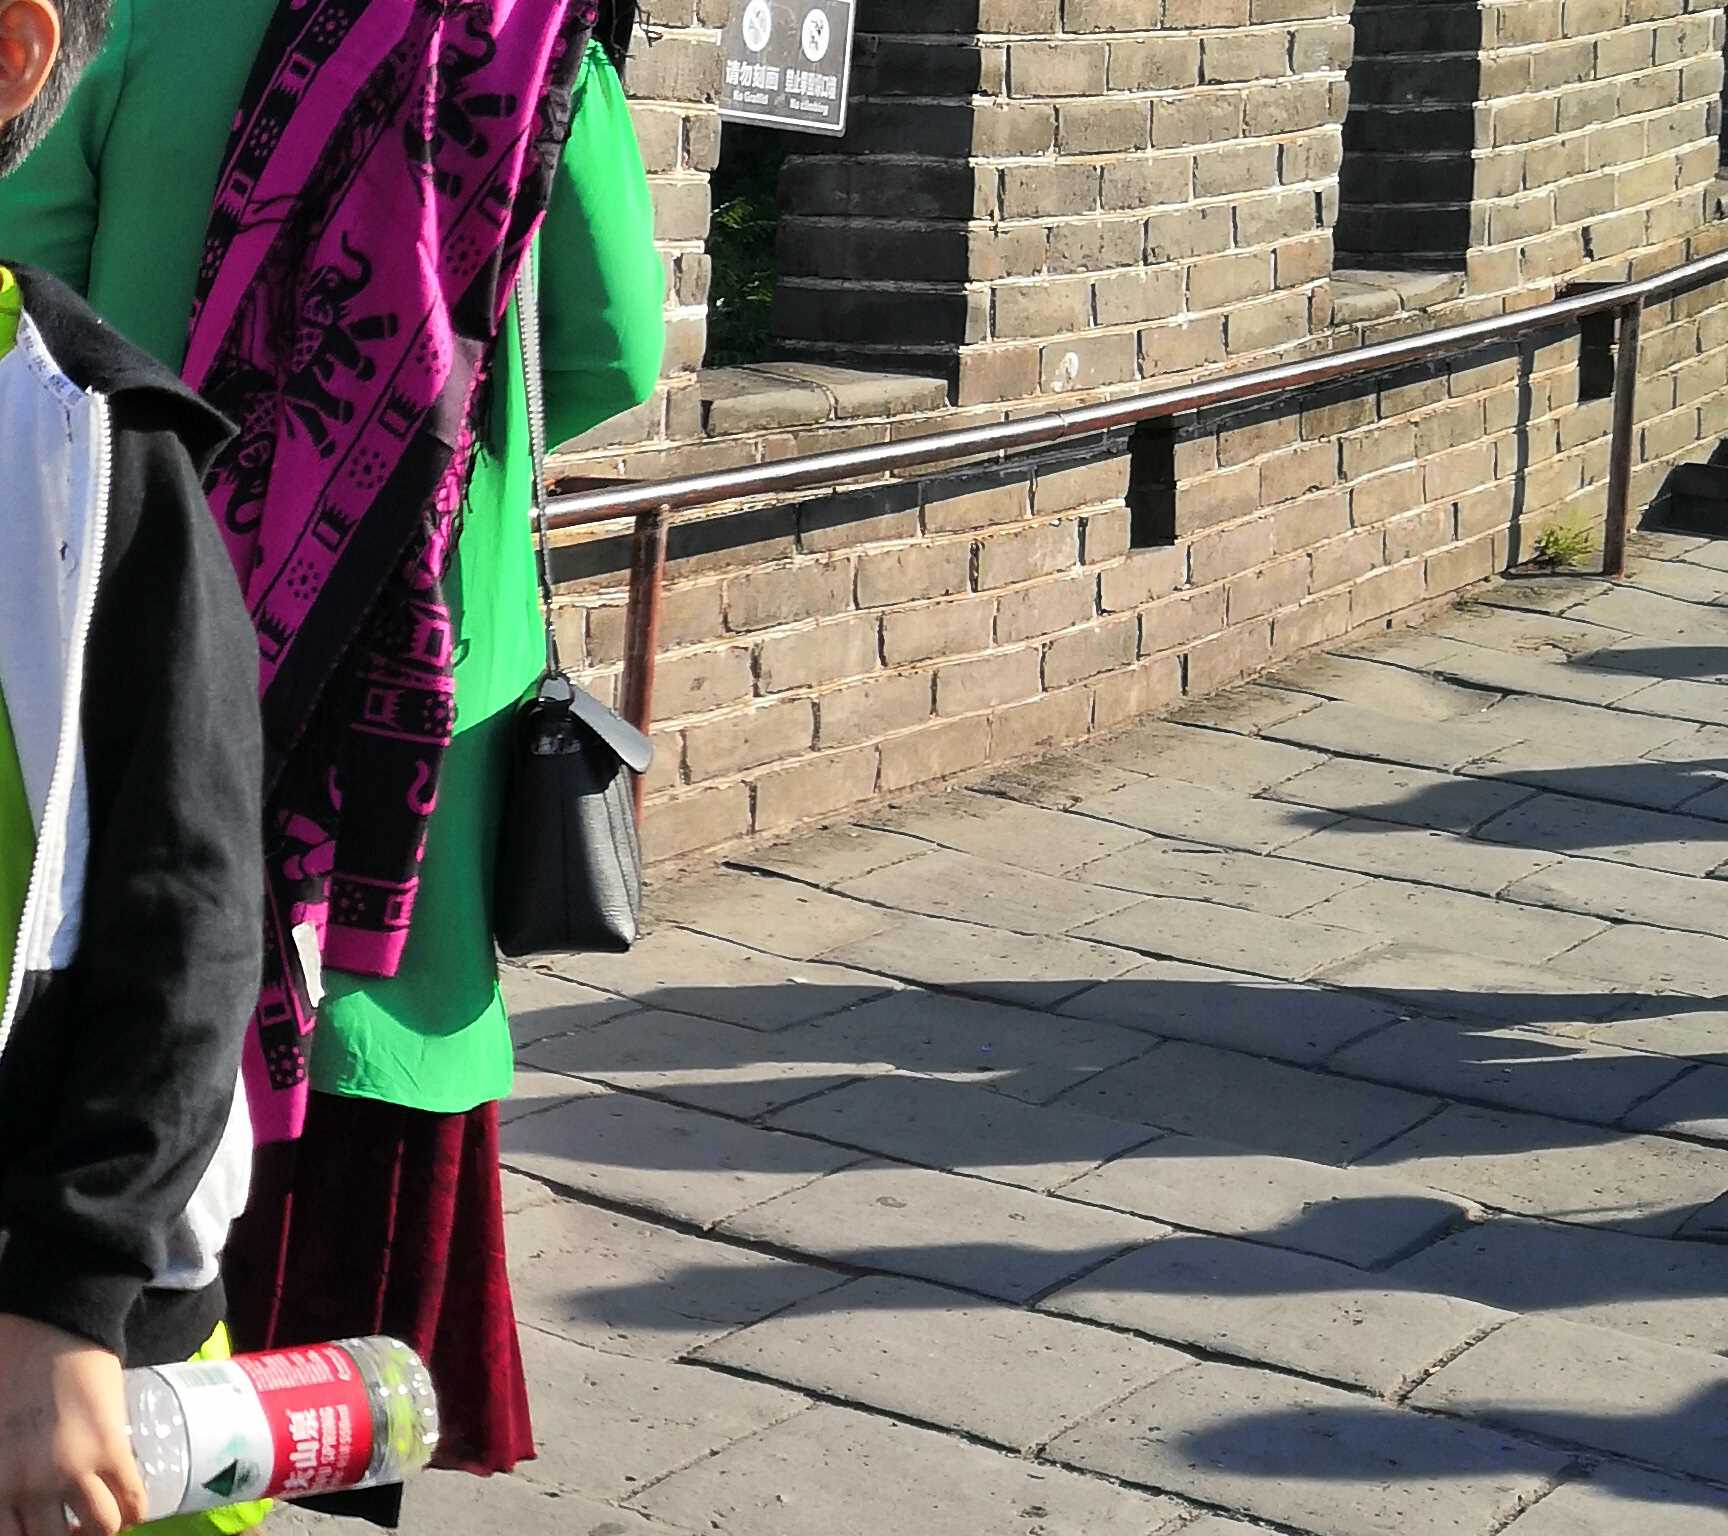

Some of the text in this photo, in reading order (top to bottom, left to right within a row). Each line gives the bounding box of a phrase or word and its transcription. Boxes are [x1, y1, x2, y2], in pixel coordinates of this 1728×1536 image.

[732, 90, 744, 102] No
[282, 1408, 319, 1498] 夫山泉
